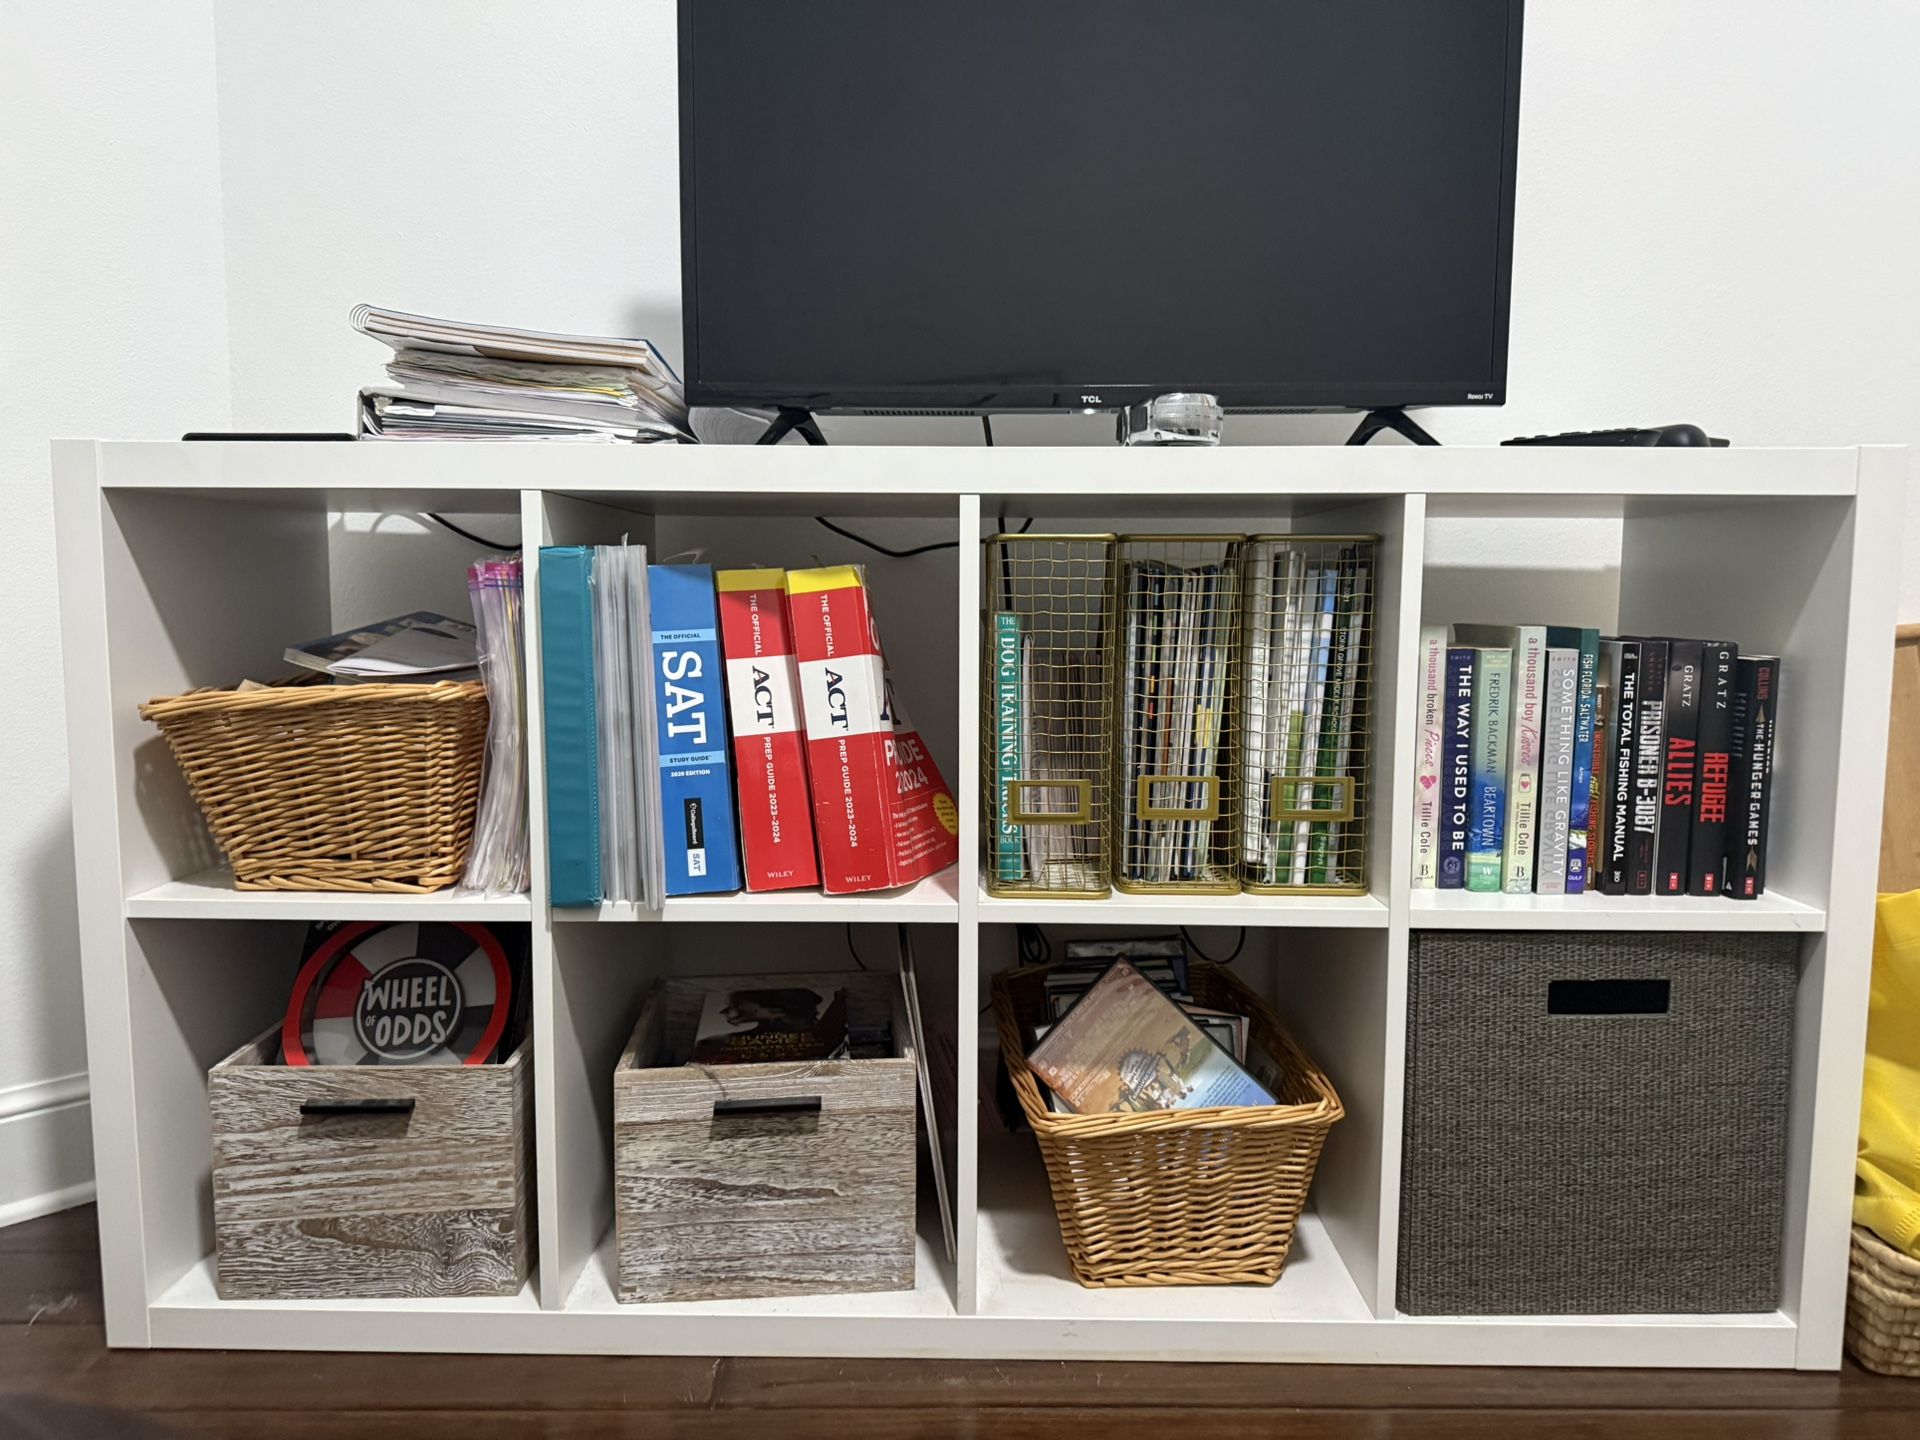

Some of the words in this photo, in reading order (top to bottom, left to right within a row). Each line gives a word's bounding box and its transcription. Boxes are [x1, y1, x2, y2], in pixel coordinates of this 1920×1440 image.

[1081, 395, 1102, 404] TCL
[821, 594, 829, 612] THE
[1344, 568, 1353, 602] 200-201
[752, 614, 762, 655] OFFICIAL
[823, 615, 835, 656] OFFICIAL
[1000, 617, 1016, 625] THE
[1001, 638, 1016, 676] DOG
[1428, 648, 1440, 691] thousand
[1525, 648, 1540, 699] thousand
[1583, 654, 1593, 669] FISH
[662, 651, 706, 744] SAT
[752, 666, 774, 726] ACT
[825, 667, 848, 729] ACT
[1458, 665, 1472, 697] THE
[1488, 673, 1501, 717] FREDRIK
[1581, 671, 1592, 702] FLORIDA:
[1623, 672, 1635, 699] THE
[1682, 665, 1694, 707] GRATZ
[1716, 651, 1729, 709] GRATZ
[1757, 667, 1770, 699] COLLINS
[1001, 684, 1017, 766] TRAINING
[1426, 693, 1438, 725] broken
[1456, 703, 1470, 738] WAY
[1522, 703, 1537, 723] boy
[1558, 669, 1574, 764] SOMETHING
[1579, 704, 1590, 742] SALTWATER
[1620, 702, 1633, 745] TOTAL
[764, 736, 772, 761] PREP
[1424, 729, 1440, 767] Pieces
[1487, 720, 1499, 773] BACKMAN
[1521, 724, 1538, 766] Kisses
[1637, 700, 1663, 774] PRISONER
[1756, 724, 1764, 740] THE
[838, 739, 848, 764] PREP
[766, 762, 776, 791] GUIDE
[841, 765, 852, 795] GUIDE
[1454, 754, 1468, 798] USED
[1556, 771, 1569, 804] LIKE
[1617, 748, 1630, 801] FISHING
[1665, 738, 1696, 805] ALLIES
[1700, 752, 1728, 822] REFUGEE
[1750, 744, 1764, 799] HUNGER
[1421, 801, 1432, 827] Tillie
[1453, 803, 1466, 825] TO
[1482, 787, 1496, 846] BEARTOWN
[1519, 802, 1531, 829] Tillie
[1634, 779, 1657, 834] B-3087
[1747, 803, 1760, 845] GAMES
[1420, 832, 1431, 854] Cole
[1452, 832, 1464, 850] BE
[1518, 833, 1529, 855] Cole
[1553, 811, 1566, 876] GRAVITY
[1613, 805, 1627, 861] MANUAL
[845, 874, 872, 883] WILEY
[364, 975, 450, 1011] WHEEL
[365, 1015, 376, 1027] OF
[375, 1010, 448, 1047] ODDS
